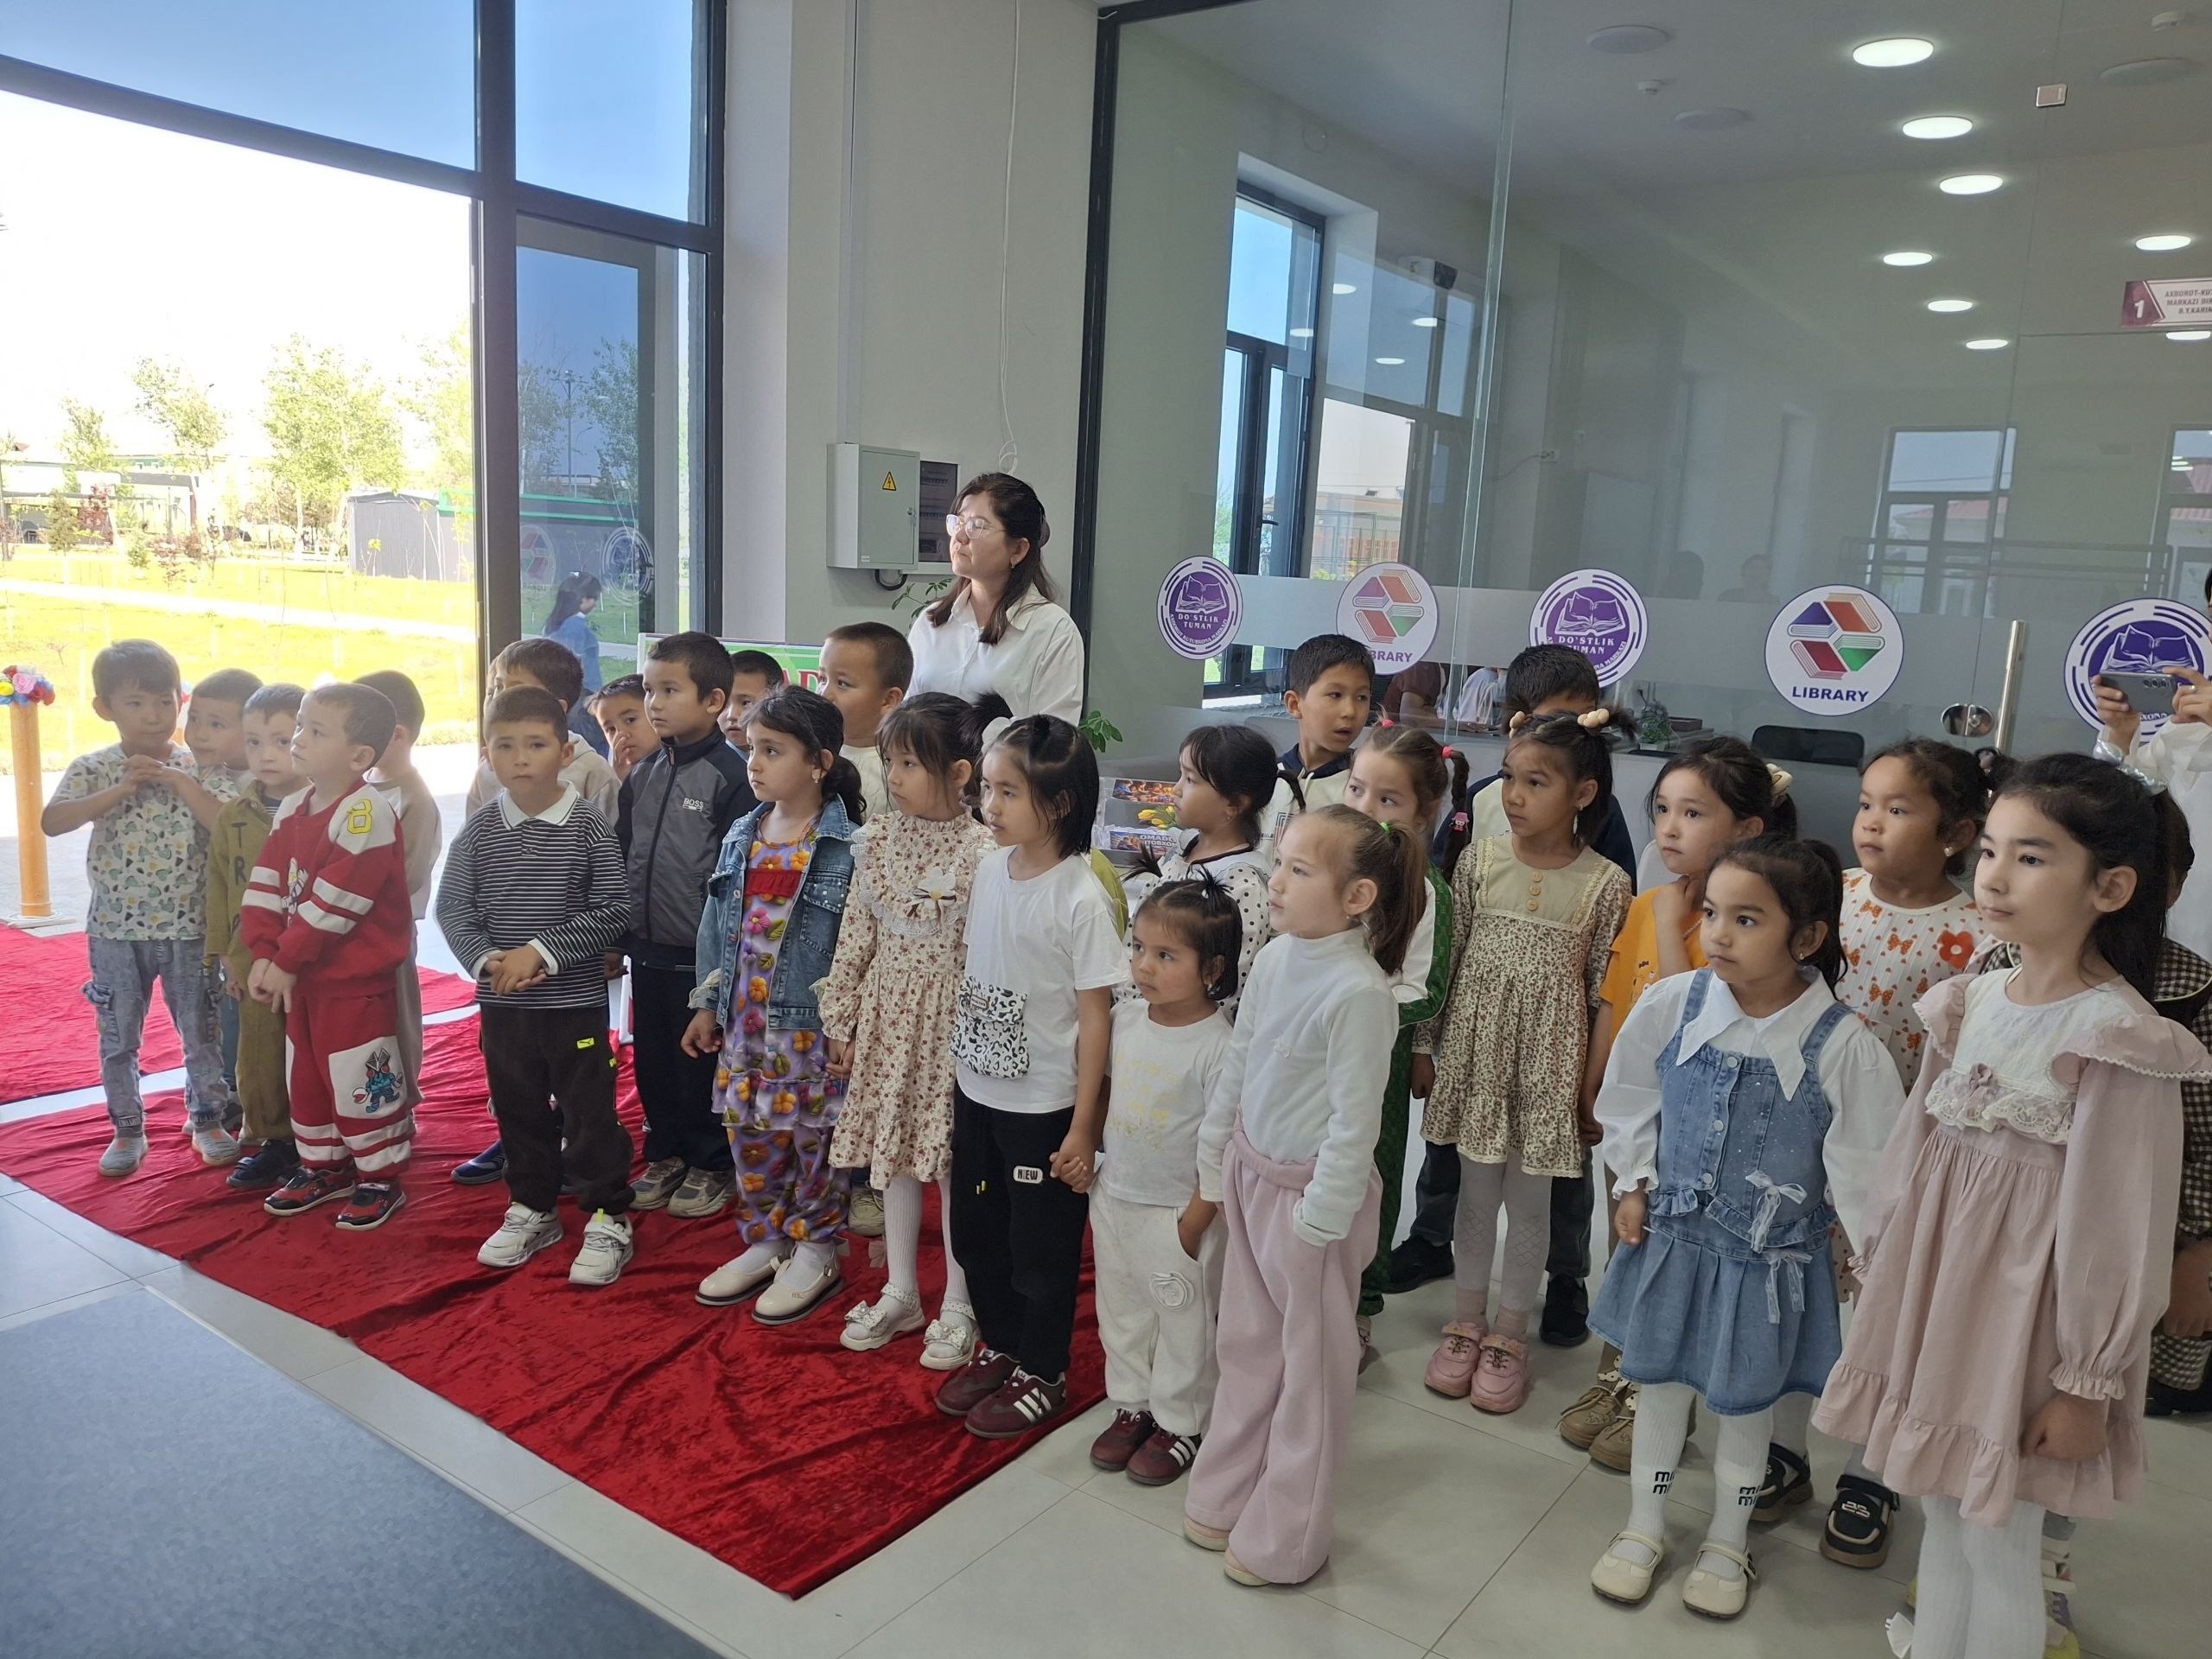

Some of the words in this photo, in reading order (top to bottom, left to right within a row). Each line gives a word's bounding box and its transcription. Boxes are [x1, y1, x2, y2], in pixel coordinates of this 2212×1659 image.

[2134, 299, 2145, 319] 1
[1184, 621, 1212, 631] TUMAN
[1369, 650, 1414, 663] BRARY
[1791, 686, 1870, 702] LIBRARY
[683, 798, 704, 808] BOSS
[346, 798, 373, 835] 8
[1018, 1169, 1038, 1180] NEW
